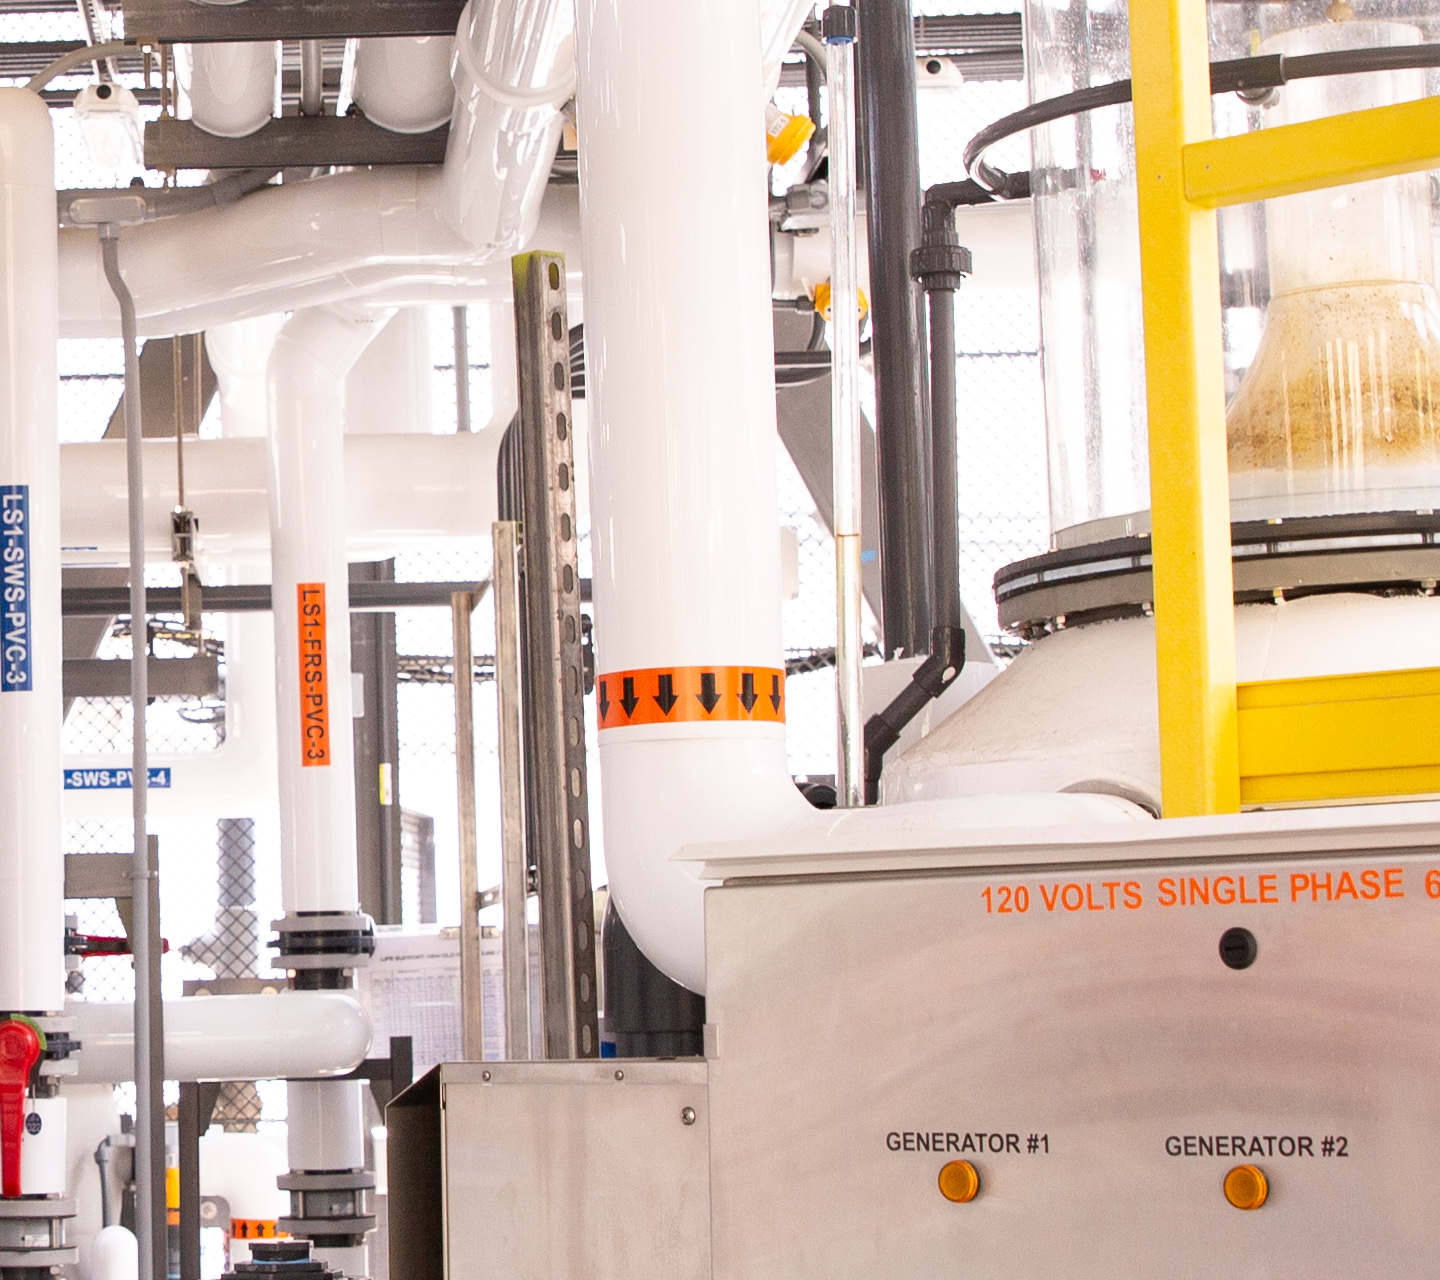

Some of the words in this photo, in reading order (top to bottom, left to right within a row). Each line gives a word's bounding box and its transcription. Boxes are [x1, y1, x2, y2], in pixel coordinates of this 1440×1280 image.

[2, 494, 27, 685] LS1-SWS-PVC-3
[302, 589, 325, 760] LS1-FRS-PVC-3
[980, 885, 1031, 914] 120
[1039, 881, 1144, 911] VOLTS
[1157, 873, 1279, 907] SINGLE
[1289, 867, 1405, 903] PHASE
[885, 1131, 1021, 1155] GENERATOR
[1026, 1131, 1051, 1155] #1
[1164, 1134, 1315, 1159] GENERATOR
[1320, 1134, 1349, 1158] #2
